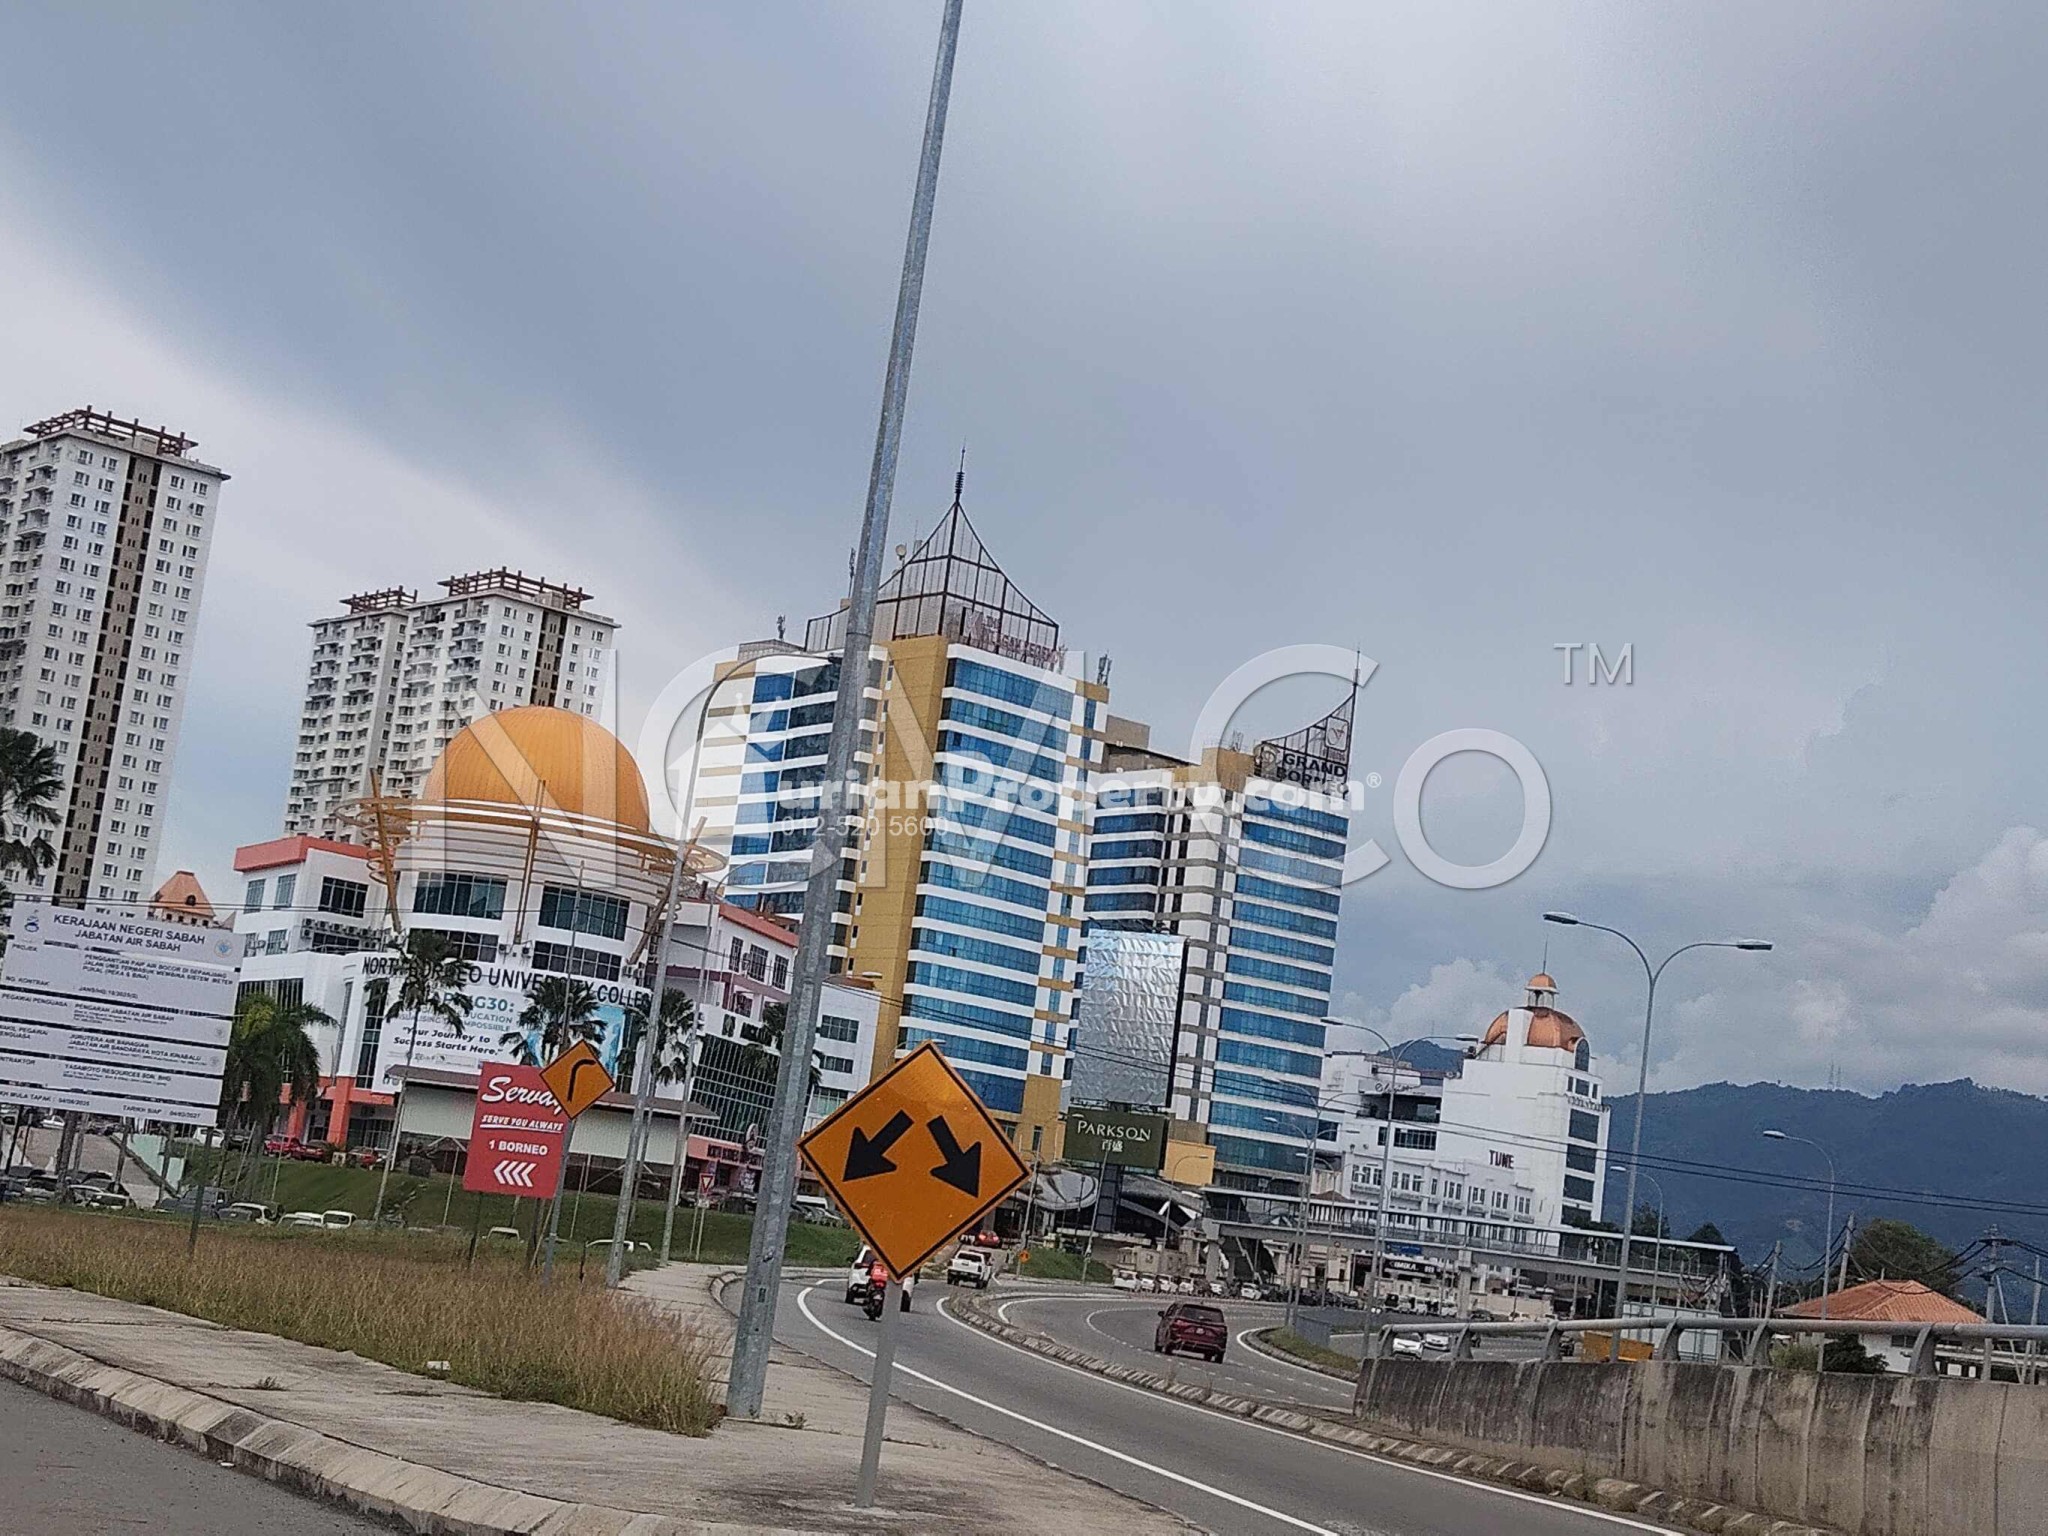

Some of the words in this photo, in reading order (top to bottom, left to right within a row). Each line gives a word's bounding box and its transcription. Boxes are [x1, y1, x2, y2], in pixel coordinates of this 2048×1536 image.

[1283, 753, 1347, 777] GRAND
[53, 914, 117, 932] KERAJAAN
[119, 923, 163, 938] NEGERI
[166, 931, 205, 945] SABAH
[75, 929, 123, 944] JABATAN
[125, 936, 143, 946] AIR
[145, 938, 181, 952] SABAH
[597, 985, 654, 1007] COLLE
[393, 1036, 432, 1048] Sucess
[435, 1040, 467, 1051] Starts
[479, 1034, 491, 1043] to
[481, 1114, 509, 1125] SERVE
[511, 1118, 529, 1127] YOU
[529, 1120, 564, 1131] ALWAYS
[1077, 1119, 1151, 1141] PARKSON
[488, 1140, 495, 1150] 1
[498, 1140, 549, 1156] BORNEO
[1489, 1149, 1515, 1170] TUNE
